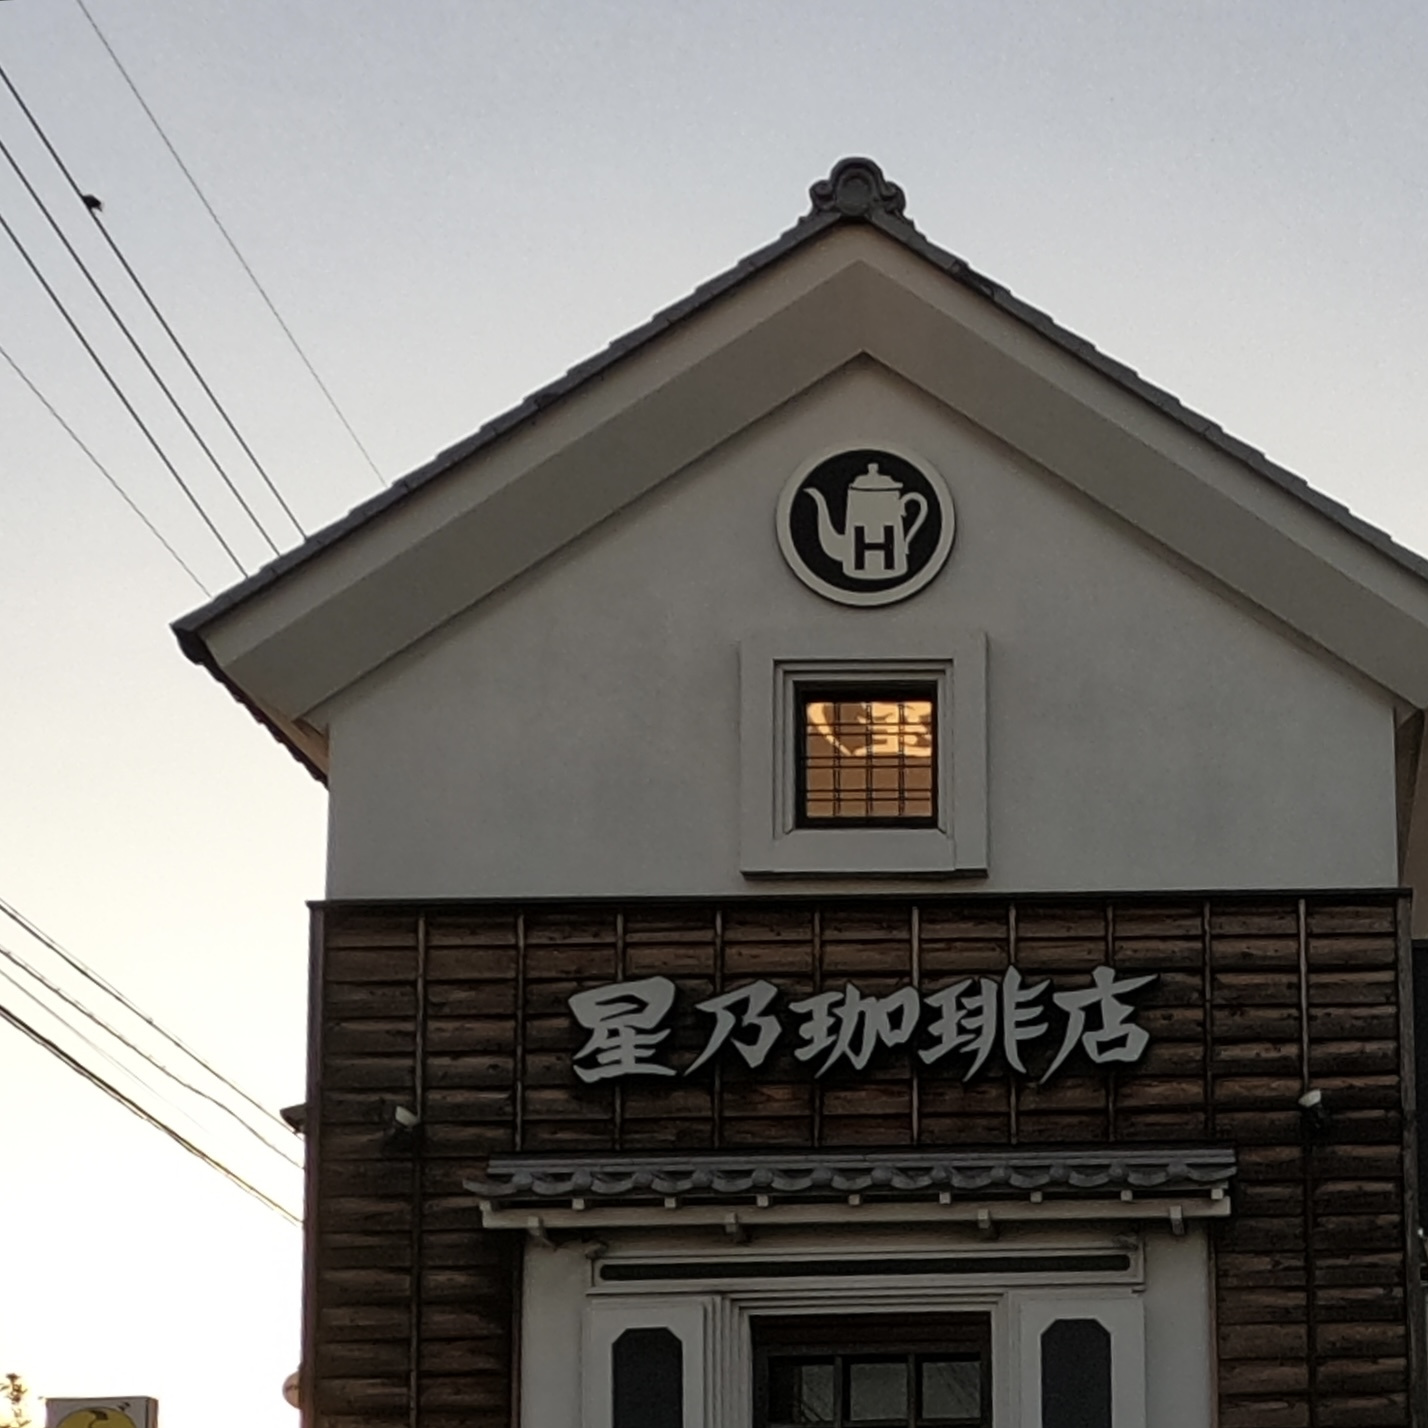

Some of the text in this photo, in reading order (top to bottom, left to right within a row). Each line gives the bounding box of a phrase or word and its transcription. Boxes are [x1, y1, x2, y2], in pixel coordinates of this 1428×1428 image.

[854, 526, 895, 570] H
[567, 966, 1159, 1083] 星乃珈琲店
